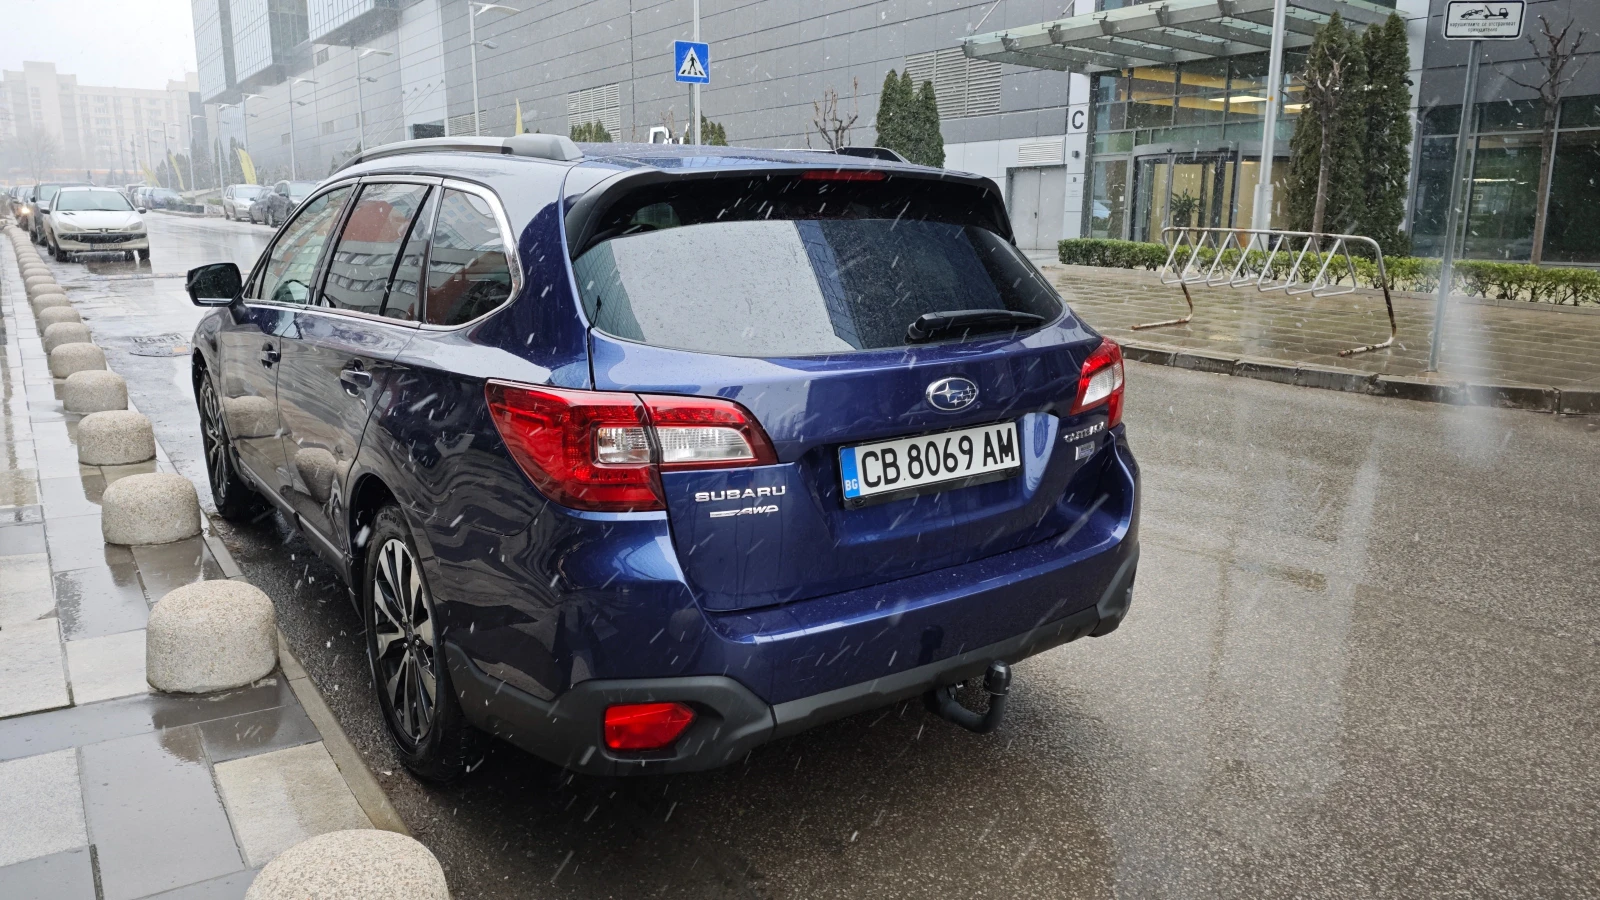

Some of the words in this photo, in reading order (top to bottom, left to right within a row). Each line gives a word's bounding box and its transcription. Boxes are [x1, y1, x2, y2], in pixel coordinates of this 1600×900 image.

[1072, 110, 1084, 129] C
[861, 447, 900, 488] CB
[907, 435, 973, 480] 8069
[983, 427, 1015, 467] AM
[695, 485, 786, 502] SUBARU
[845, 479, 858, 491] BG
[737, 505, 779, 515] AWD
